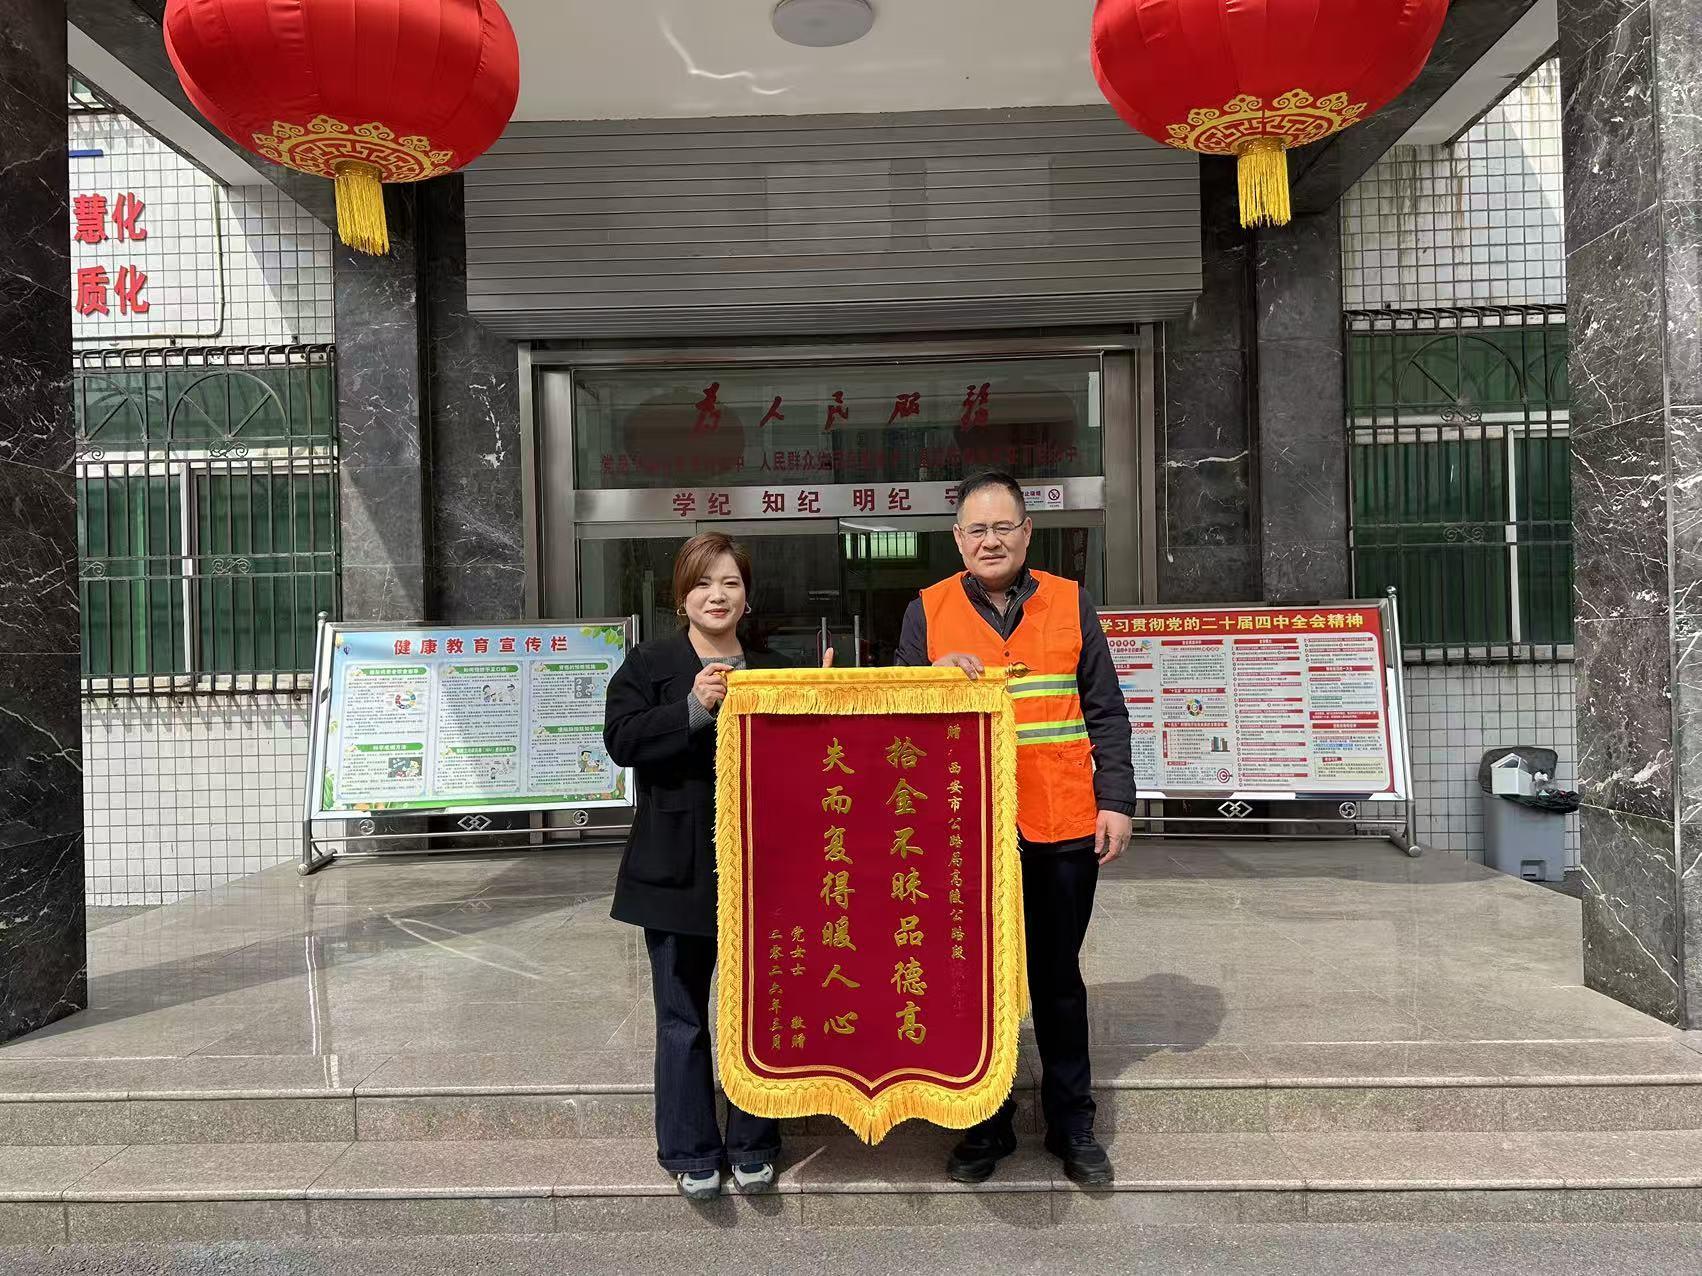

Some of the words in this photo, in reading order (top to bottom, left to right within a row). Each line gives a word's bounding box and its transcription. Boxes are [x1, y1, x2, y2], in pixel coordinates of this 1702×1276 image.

[73, 192, 147, 244] 慧化
[75, 265, 151, 317] 质化
[672, 491, 732, 517] 学纪
[762, 490, 821, 514] 知纪
[852, 487, 912, 512] 明纪
[394, 636, 569, 657] 健康教育宣传栏
[1098, 612, 1364, 633] 学习贯彻党的二十届四中全会精神
[820, 737, 861, 1035] 失而复得暖人心
[885, 735, 930, 1045] 拾金不昧品德高
